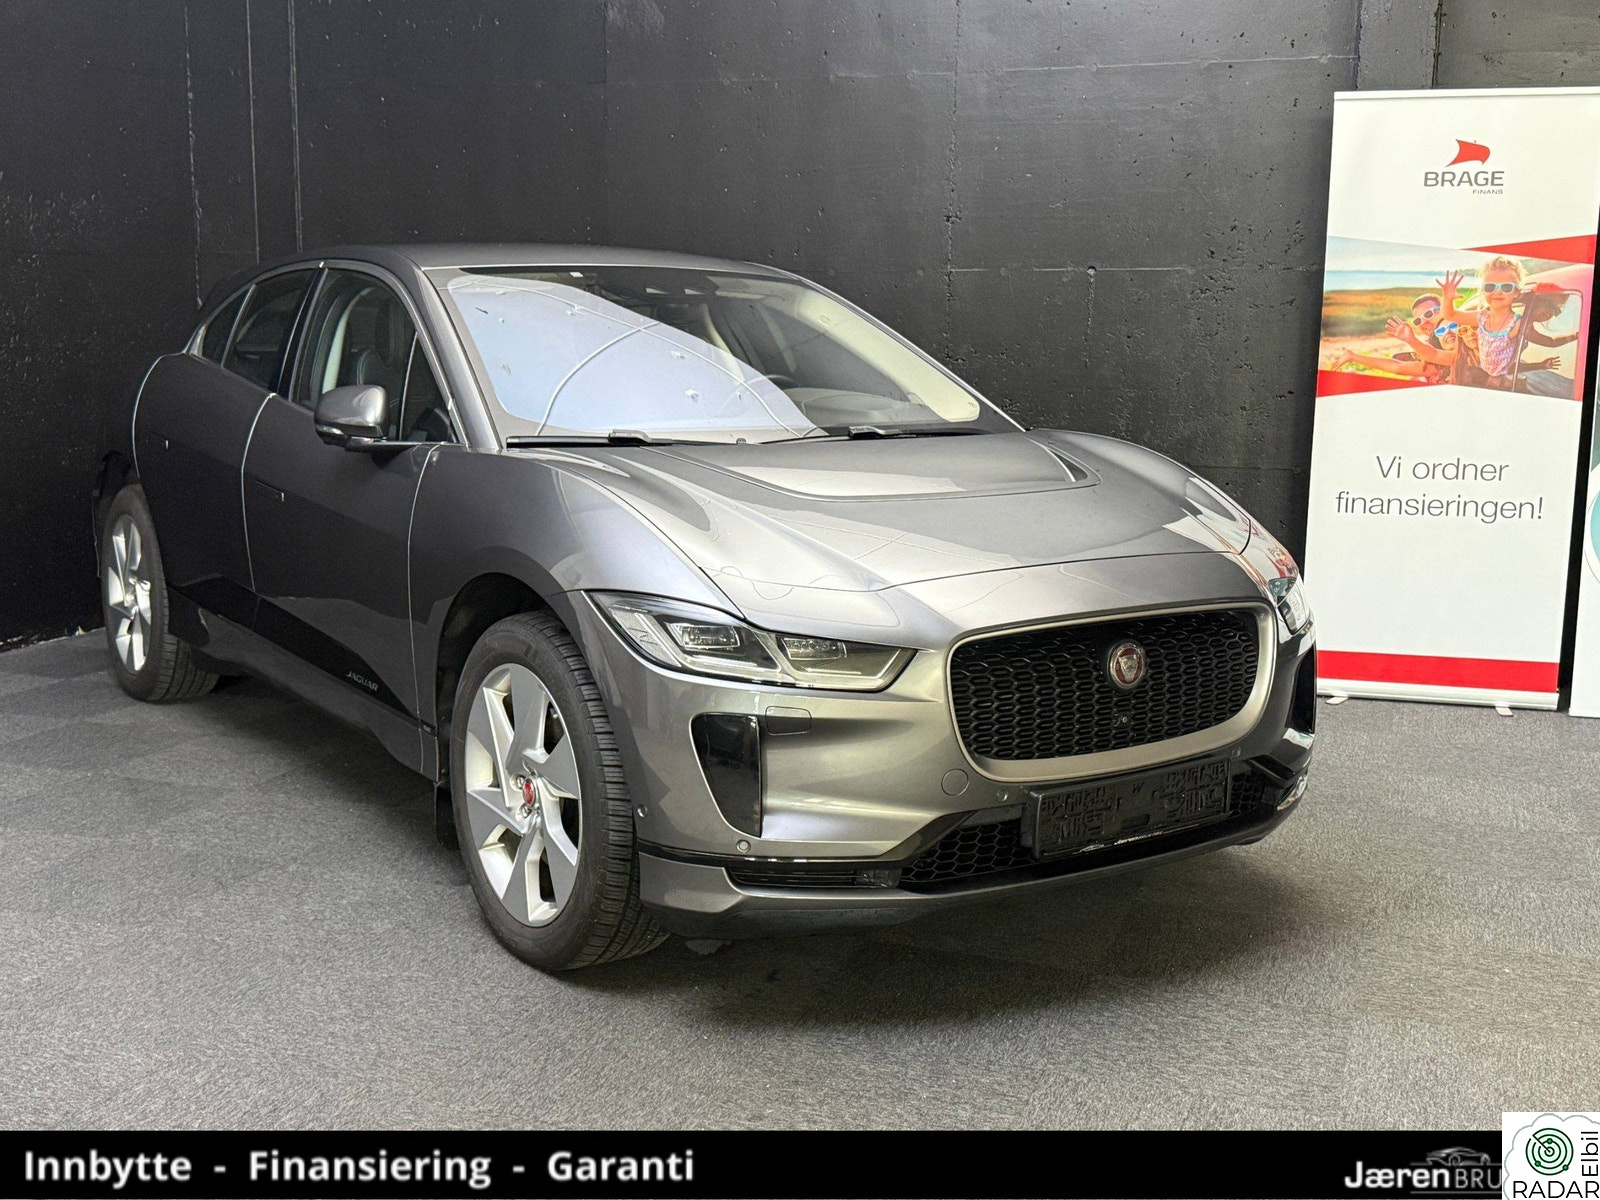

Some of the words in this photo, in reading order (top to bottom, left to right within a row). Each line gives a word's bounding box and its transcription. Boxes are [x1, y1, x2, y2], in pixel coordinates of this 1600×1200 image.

[1423, 170, 1505, 187] BRAGE
[1376, 455, 1402, 479] Vi
[1412, 457, 1510, 482] ordner
[1335, 491, 1543, 524] finansieringen!
[345, 670, 379, 692] JAGUAR
